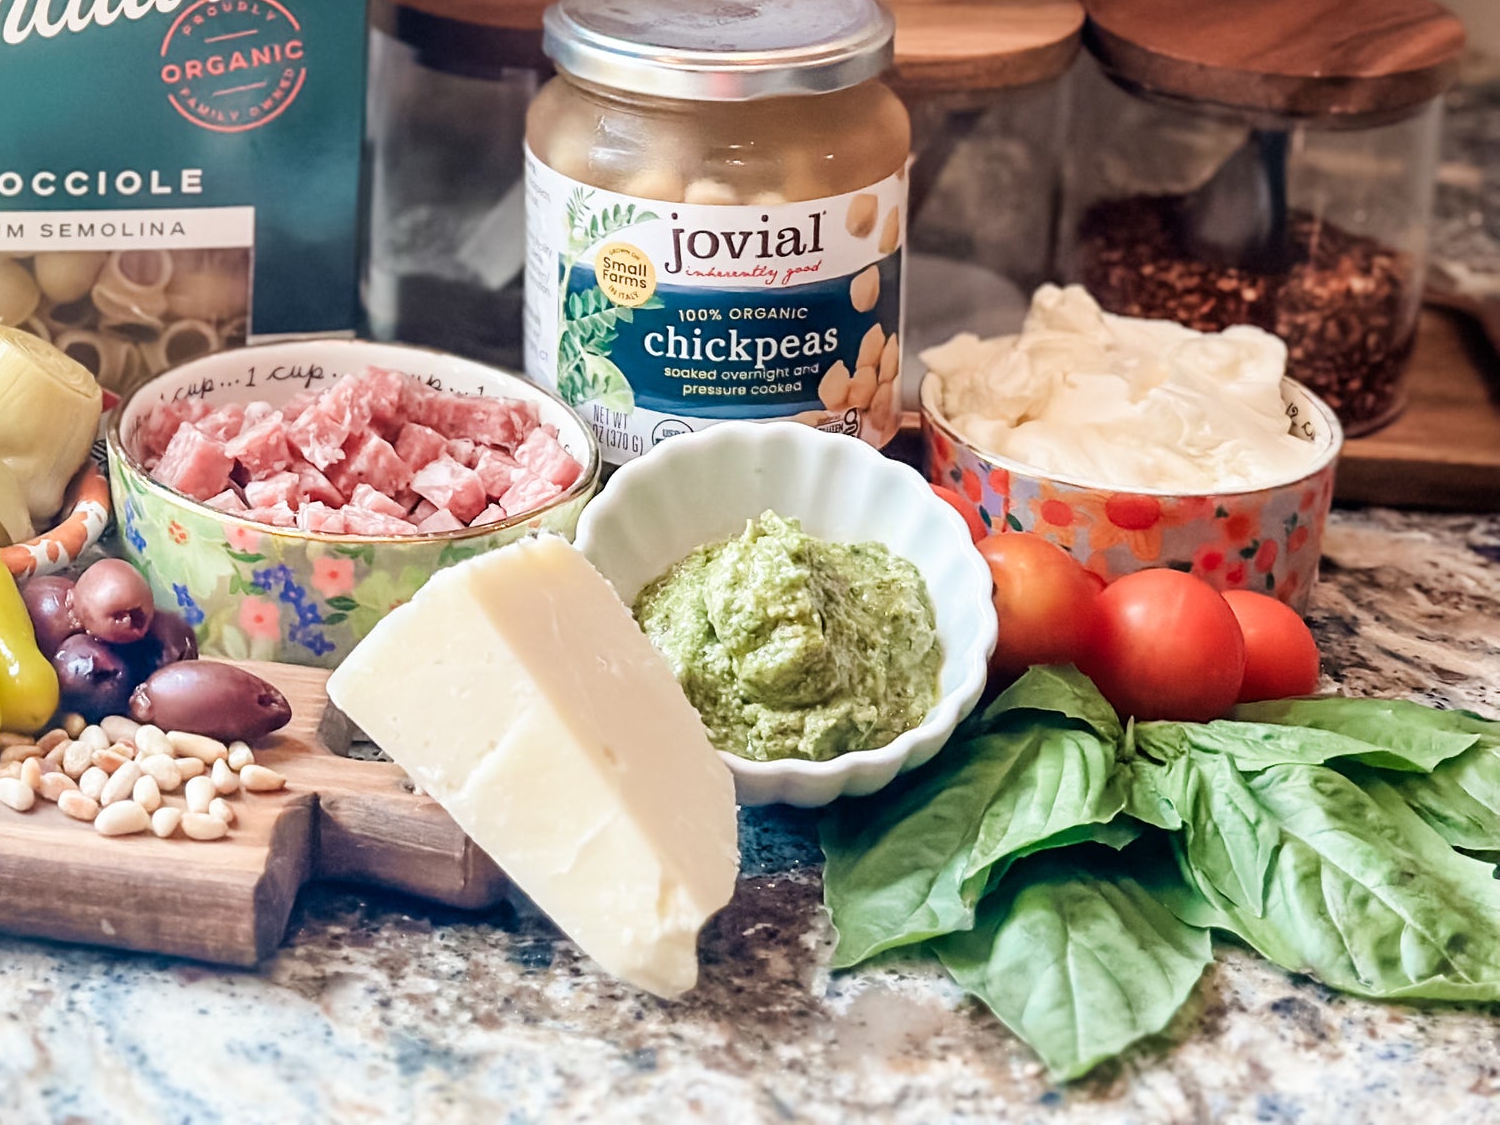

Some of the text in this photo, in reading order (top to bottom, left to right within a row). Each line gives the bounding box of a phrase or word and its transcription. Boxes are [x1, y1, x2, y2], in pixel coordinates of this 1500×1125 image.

[182, 0, 277, 36] PROUDLY
[160, 40, 304, 83] ORGANIC
[180, 68, 295, 121] FAMILY OWNED
[40, 221, 186, 238] SEMOLINA
[664, 212, 825, 274] jovial
[602, 269, 647, 288] Farms
[603, 256, 647, 277] Small
[685, 259, 823, 285] inherently good
[678, 307, 809, 322] 100% ORGANIC
[643, 325, 839, 369] chickpeas
[664, 363, 820, 386] soaked overnight and
[682, 381, 802, 397] pressure cooked
[593, 405, 629, 430] NET WT
[606, 429, 629, 450] (370
[632, 435, 644, 456] G)
